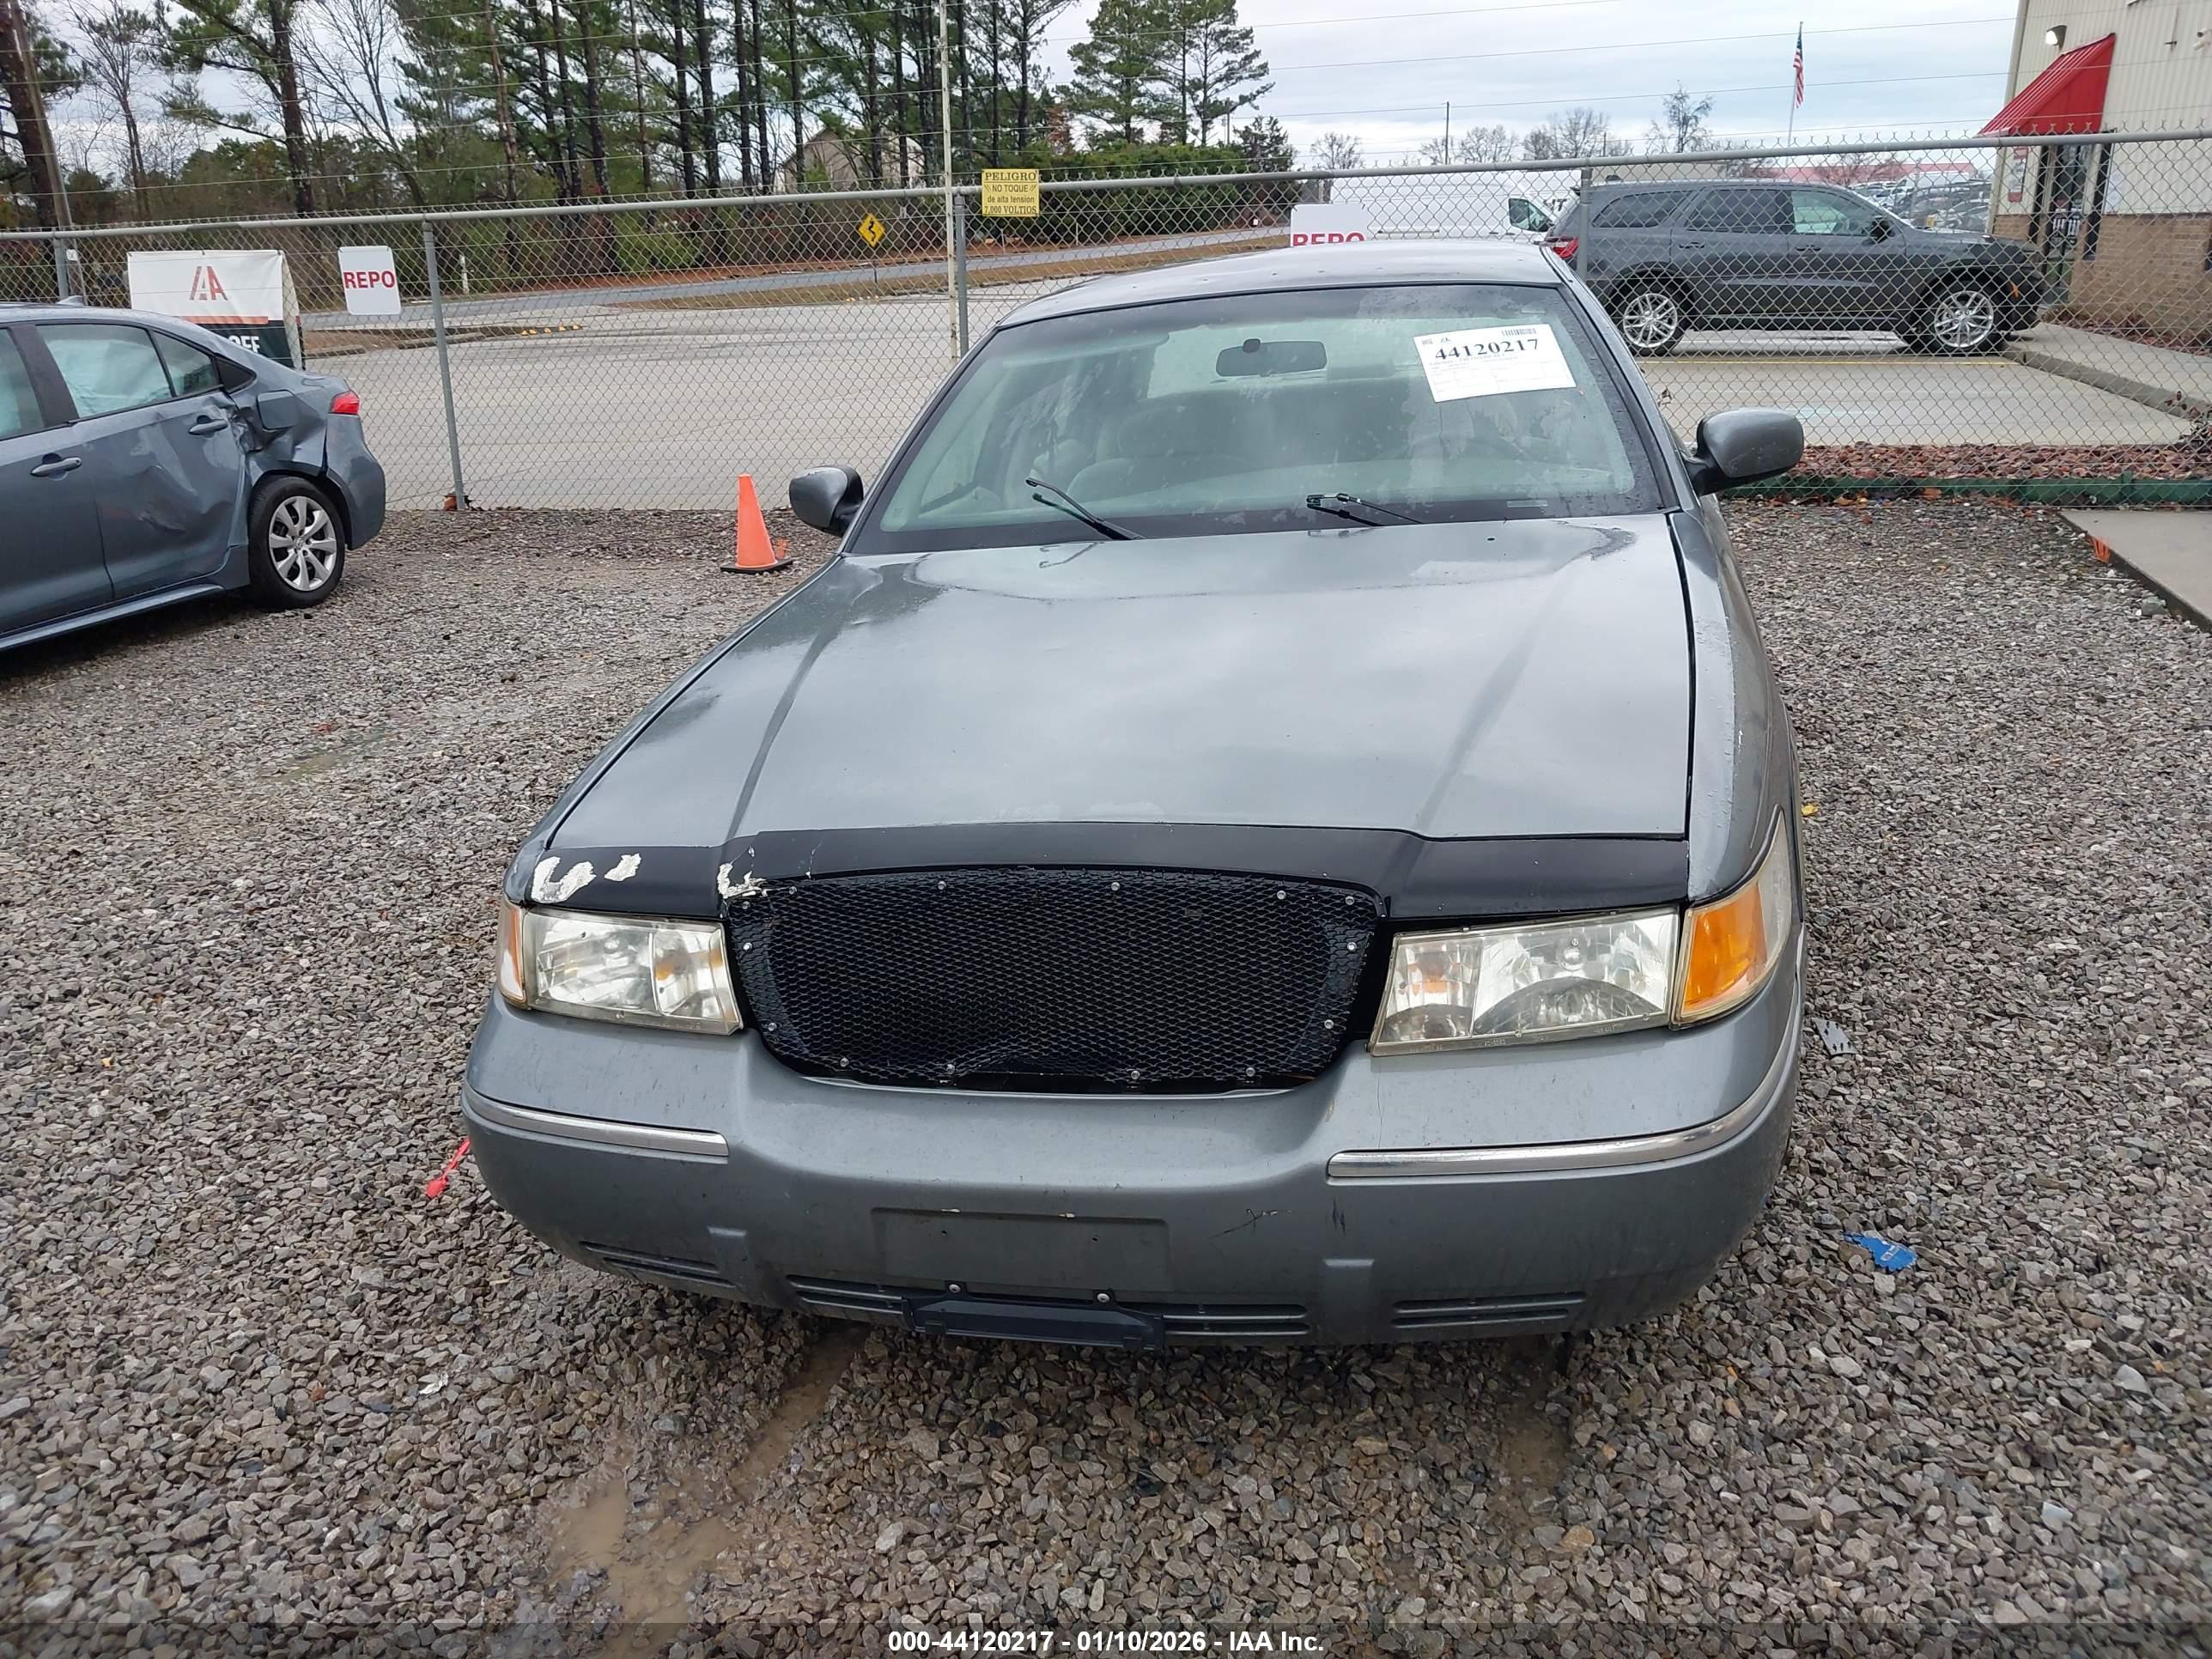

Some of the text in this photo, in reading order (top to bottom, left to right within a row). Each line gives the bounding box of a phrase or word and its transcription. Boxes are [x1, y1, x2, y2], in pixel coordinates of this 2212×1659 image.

[985, 172, 1036, 181] PELIGRO
[992, 184, 1029, 193] NO TOQUE
[987, 195, 1035, 204] de alta tension
[1003, 205, 1037, 215] VOLTIOS
[343, 270, 396, 289] REPO
[1435, 338, 1539, 361] 44120217
